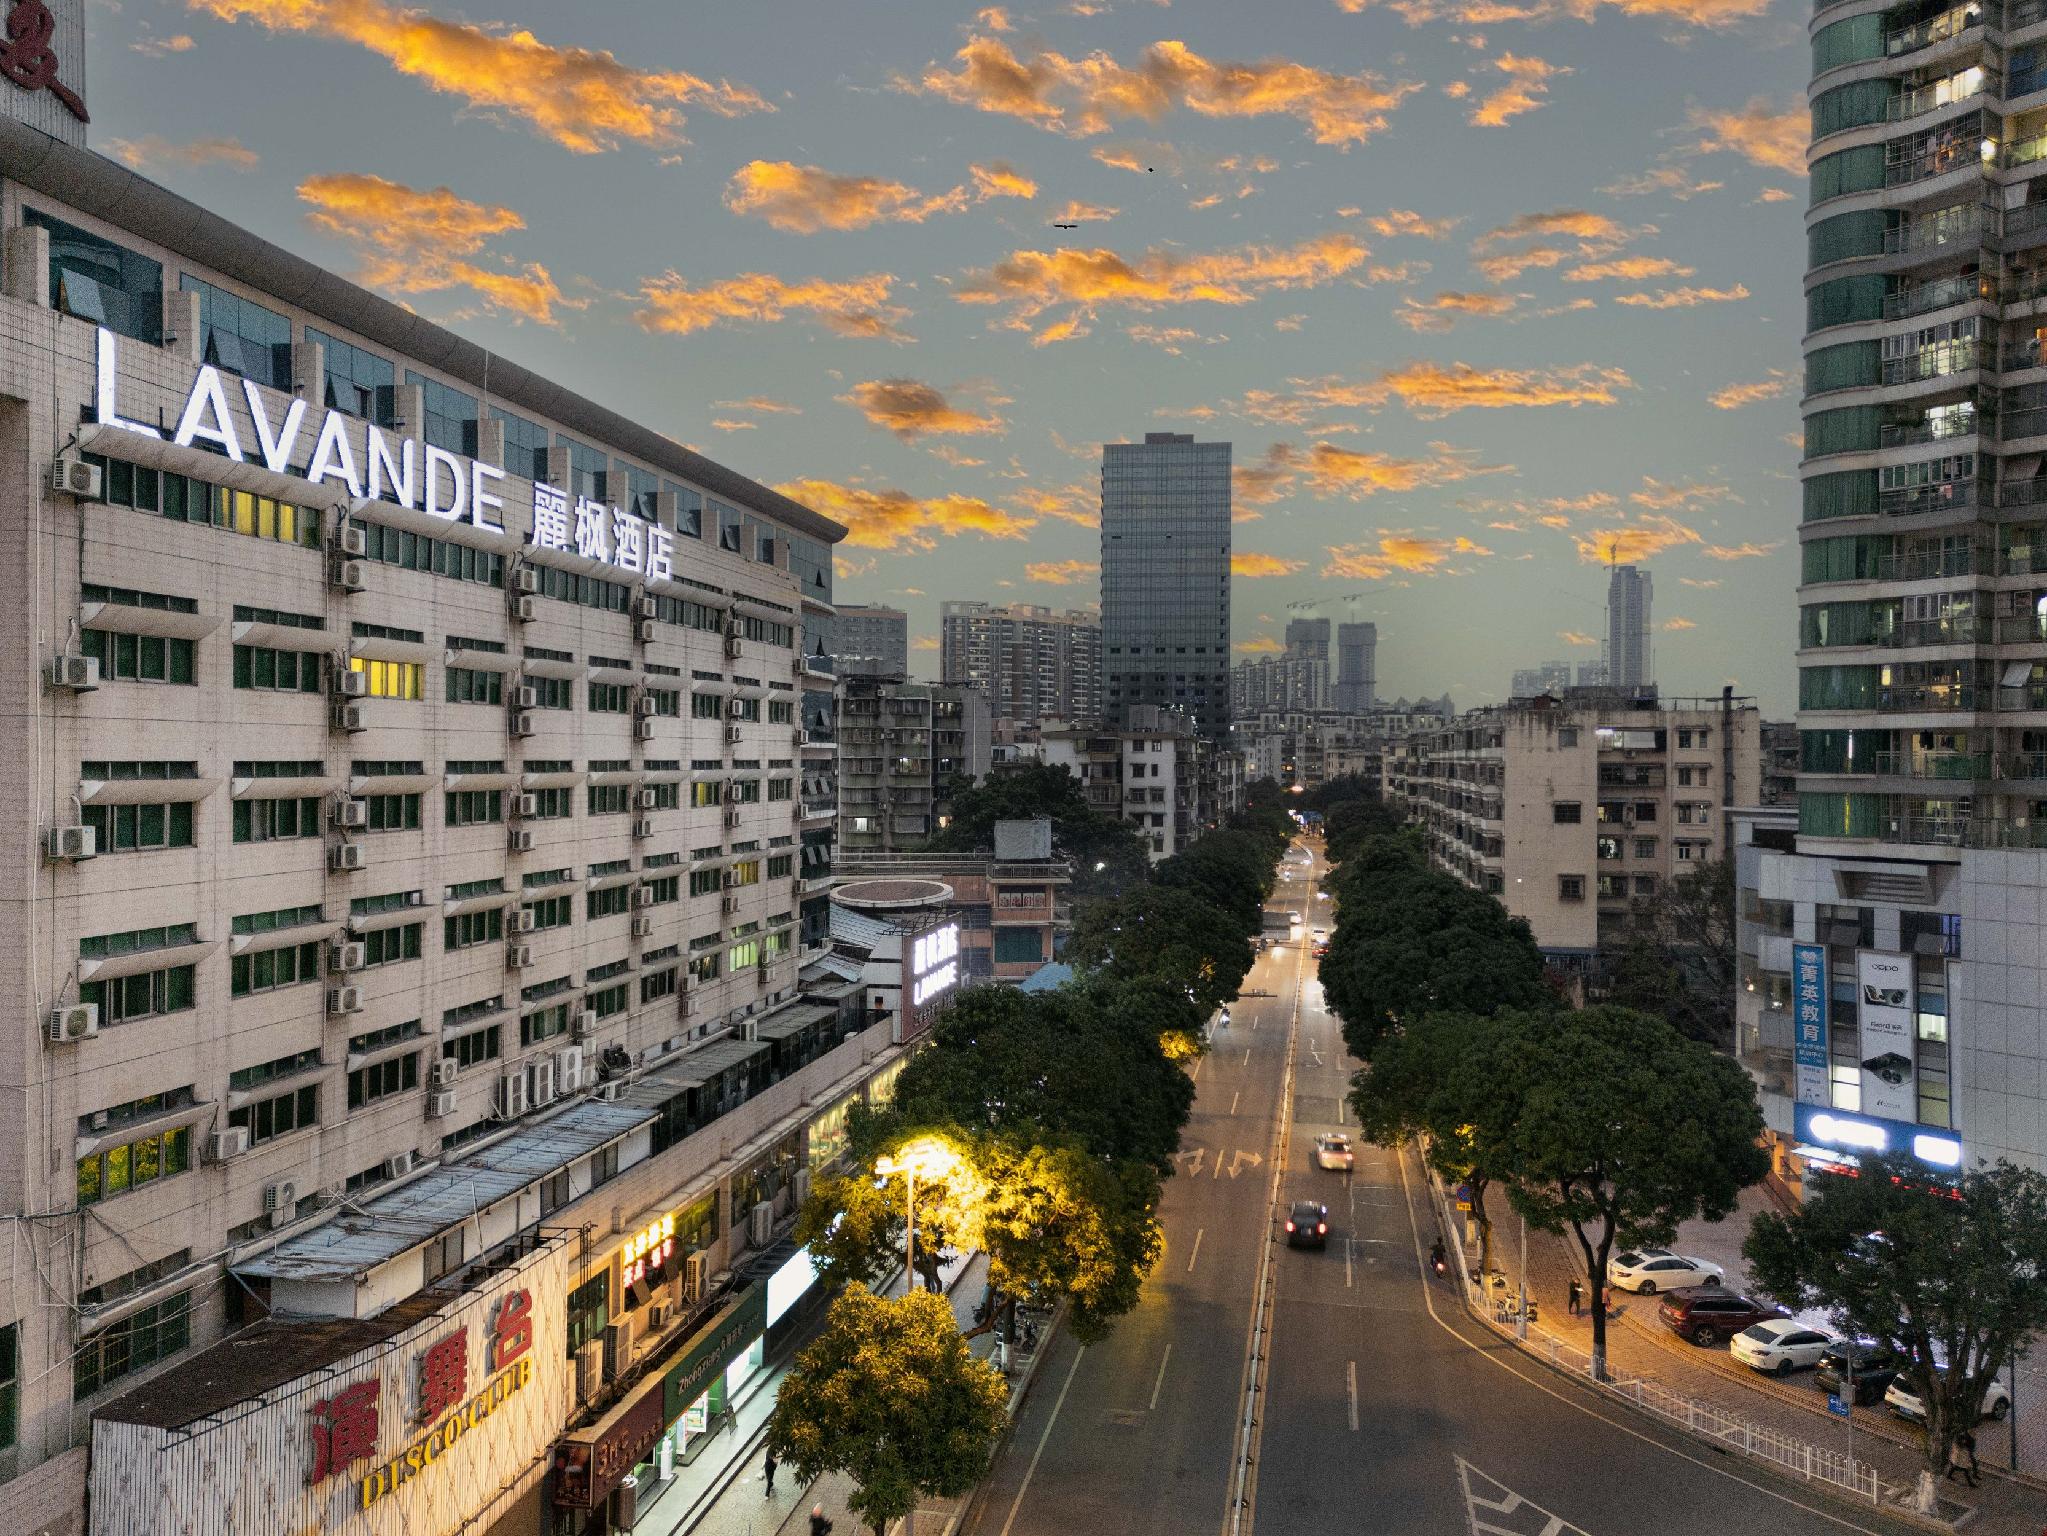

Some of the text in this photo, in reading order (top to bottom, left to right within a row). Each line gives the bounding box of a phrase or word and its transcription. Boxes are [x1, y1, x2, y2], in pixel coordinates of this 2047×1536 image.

[98, 326, 505, 535] LAVANDE
[362, 1356, 532, 1509] DISCO CLUB
